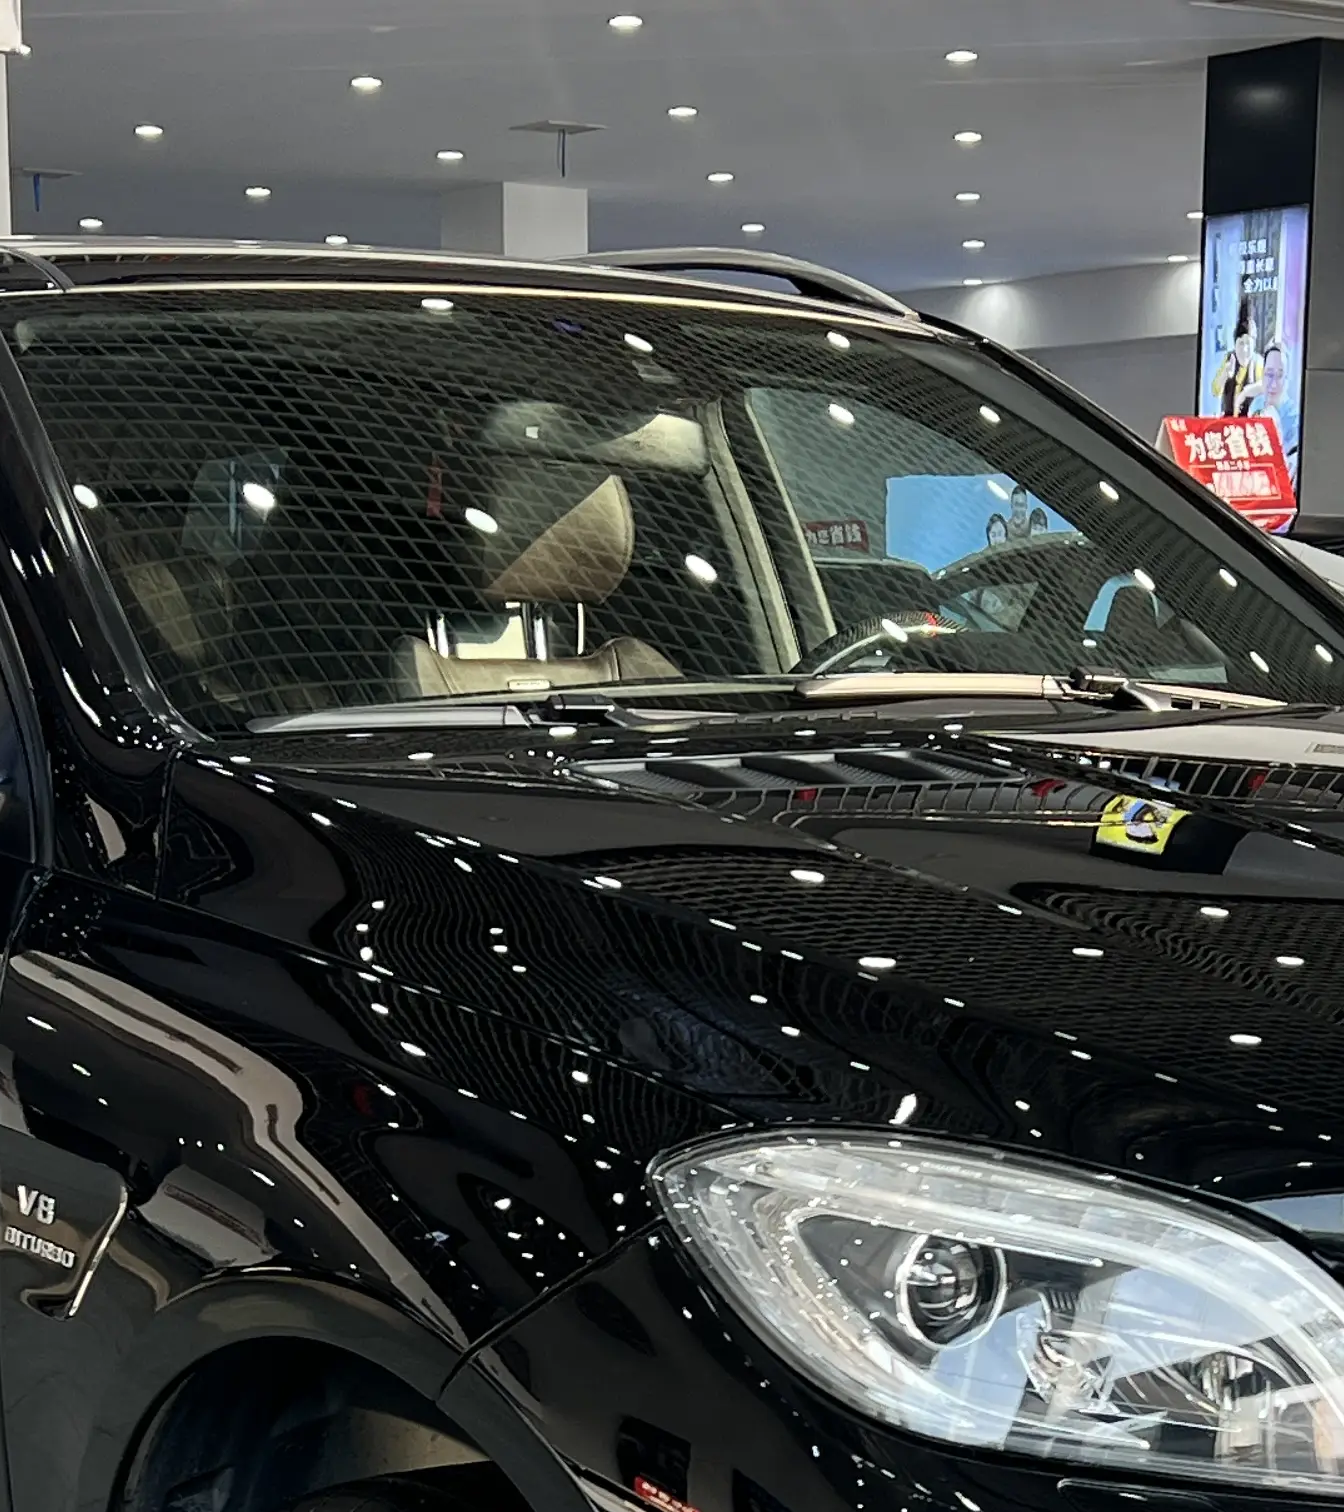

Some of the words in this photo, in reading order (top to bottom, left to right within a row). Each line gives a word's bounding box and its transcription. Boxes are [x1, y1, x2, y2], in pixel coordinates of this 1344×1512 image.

[1184, 422, 1274, 463] 为您省钱
[17, 1185, 55, 1224] V8
[5, 1226, 75, 1268] BITURBO
